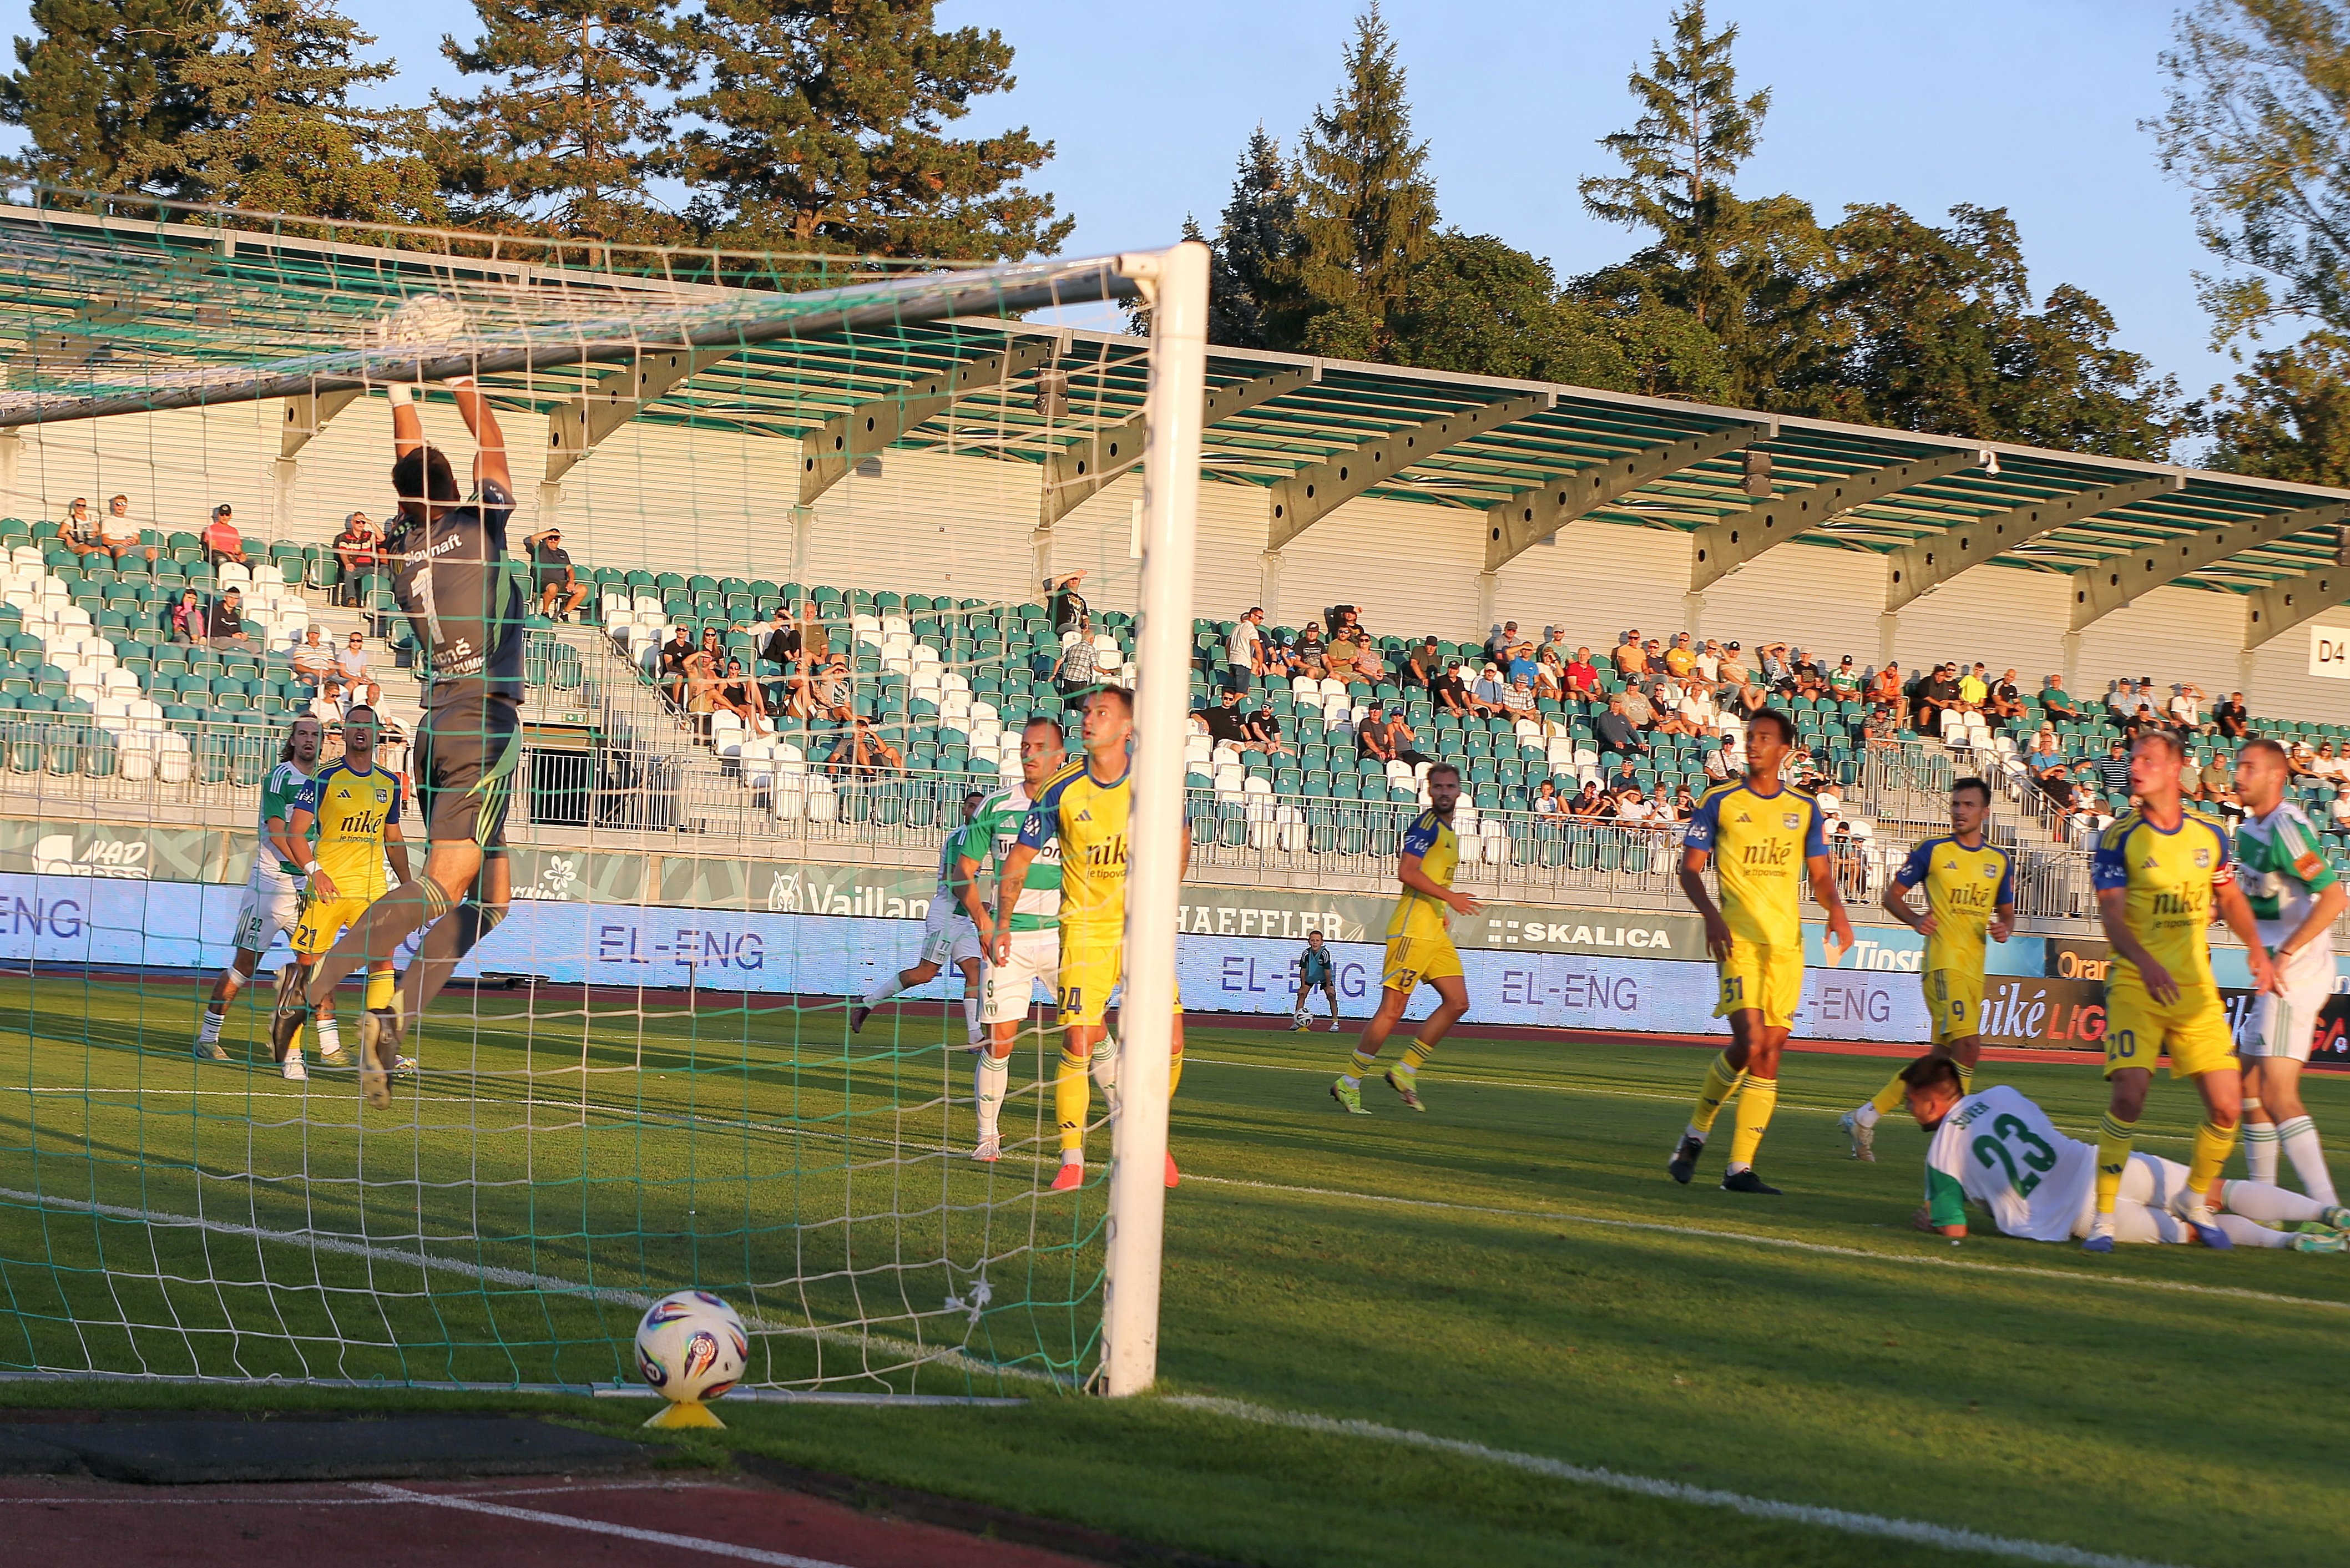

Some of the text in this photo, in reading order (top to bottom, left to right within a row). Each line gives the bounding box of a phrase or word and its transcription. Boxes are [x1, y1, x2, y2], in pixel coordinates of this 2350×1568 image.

[403, 533, 463, 566] Slovnaft
[411, 566, 445, 645] 1
[2319, 640, 2345, 664] D4
[341, 810, 383, 833] niké
[78, 840, 147, 864] NAD
[1742, 837, 1792, 866] niké
[807, 882, 937, 919] Vaillan
[1949, 883, 1990, 908] niké
[2152, 881, 2206, 914] niké
[251, 917, 263, 932] 22
[297, 925, 317, 948] 21
[1522, 922, 1672, 949] SKALICA
[599, 925, 764, 970] EL-ENG
[987, 979, 994, 998] 9
[1399, 968, 1417, 987] 13
[1502, 970, 1638, 1011] EL-ENG
[1724, 976, 1743, 1003] 31
[1059, 987, 1082, 1015] 24
[1952, 1000, 1964, 1021] 9
[2046, 1003, 2108, 1041] LIG
[2108, 1029, 2135, 1060] 20
[1972, 1112, 2057, 1201] 23
